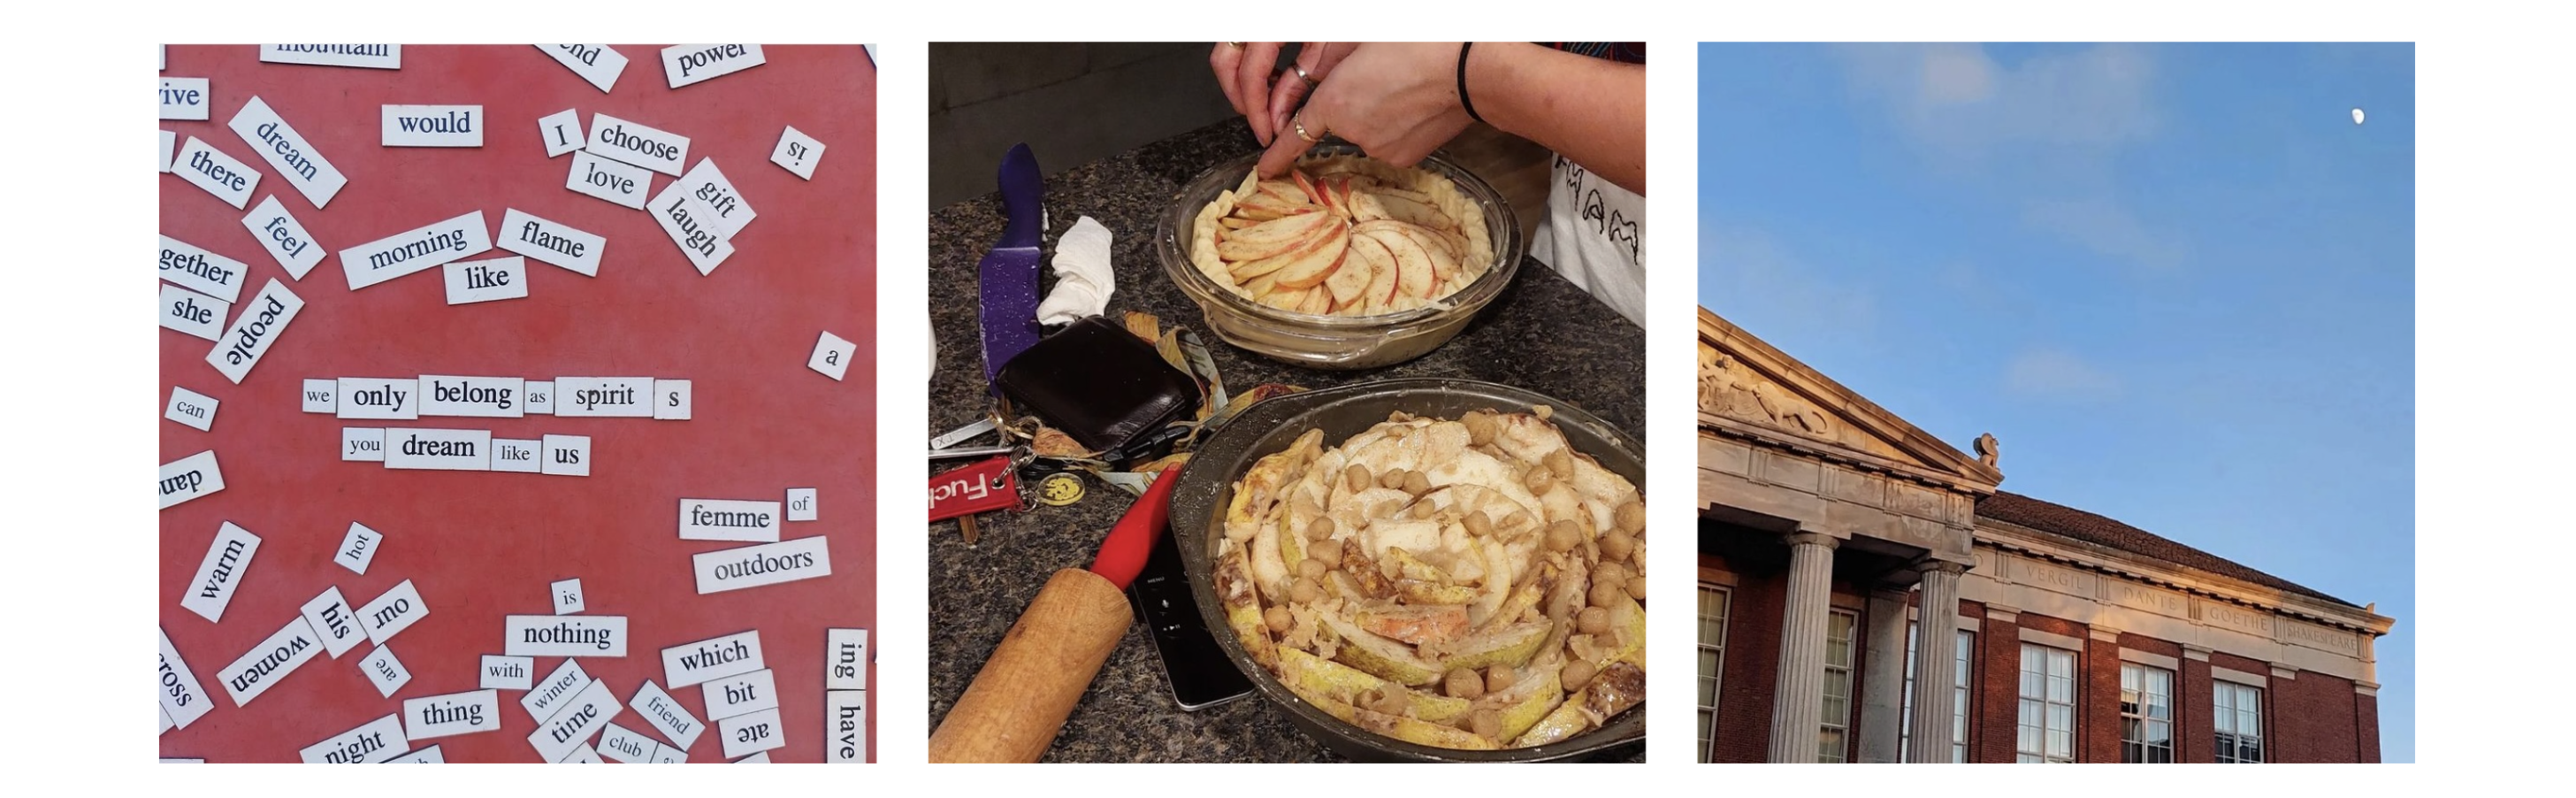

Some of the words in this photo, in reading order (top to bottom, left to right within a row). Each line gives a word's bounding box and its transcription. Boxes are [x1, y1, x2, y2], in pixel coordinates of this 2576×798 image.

[678, 44, 746, 77] power
[159, 82, 200, 106] ive
[399, 111, 470, 133] would
[555, 125, 568, 146] I
[256, 122, 317, 182] dream
[601, 126, 677, 160] choose
[788, 142, 807, 165] is
[189, 150, 246, 192] there
[585, 163, 634, 194] love
[696, 183, 734, 218] gift
[264, 216, 307, 259] feel
[520, 221, 585, 257] flame
[666, 197, 717, 257] laugh
[370, 230, 467, 269] morning
[159, 249, 233, 286] gether
[465, 266, 509, 289] like
[172, 298, 211, 324] she
[226, 294, 285, 365] people
[826, 350, 838, 365] a
[176, 400, 205, 419] can
[307, 392, 329, 402] we
[355, 385, 406, 411] only
[434, 380, 512, 409] belong
[531, 394, 546, 403] as
[577, 384, 634, 411] spirit
[669, 392, 678, 406] s
[350, 441, 379, 454] you
[402, 434, 475, 457] dream
[501, 445, 531, 460] like
[555, 449, 578, 464] us
[159, 470, 203, 496] dan
[692, 505, 769, 527] femme
[792, 495, 810, 510] of
[346, 534, 369, 560] hot
[201, 540, 245, 598] warm
[715, 552, 813, 579] outdoors
[2026, 564, 2083, 590] VERGIL
[563, 591, 576, 604] is
[2124, 587, 2177, 610] DANTE
[320, 602, 350, 639] his
[374, 599, 409, 629] our
[2210, 606, 2268, 632] GOETHE
[524, 623, 610, 649] nothing
[2287, 625, 2357, 651] SHAKESPEARE
[231, 636, 310, 692] women
[680, 639, 750, 671] which
[835, 643, 861, 679] ing
[376, 658, 397, 682] are
[490, 664, 523, 678] with
[534, 670, 577, 709] winter
[724, 684, 755, 704] bit
[423, 702, 483, 725] thing
[551, 702, 598, 744] time
[647, 696, 691, 735] friend
[608, 736, 642, 756] club
[738, 724, 768, 742] ate
[840, 706, 860, 758] have
[325, 732, 385, 763] night
